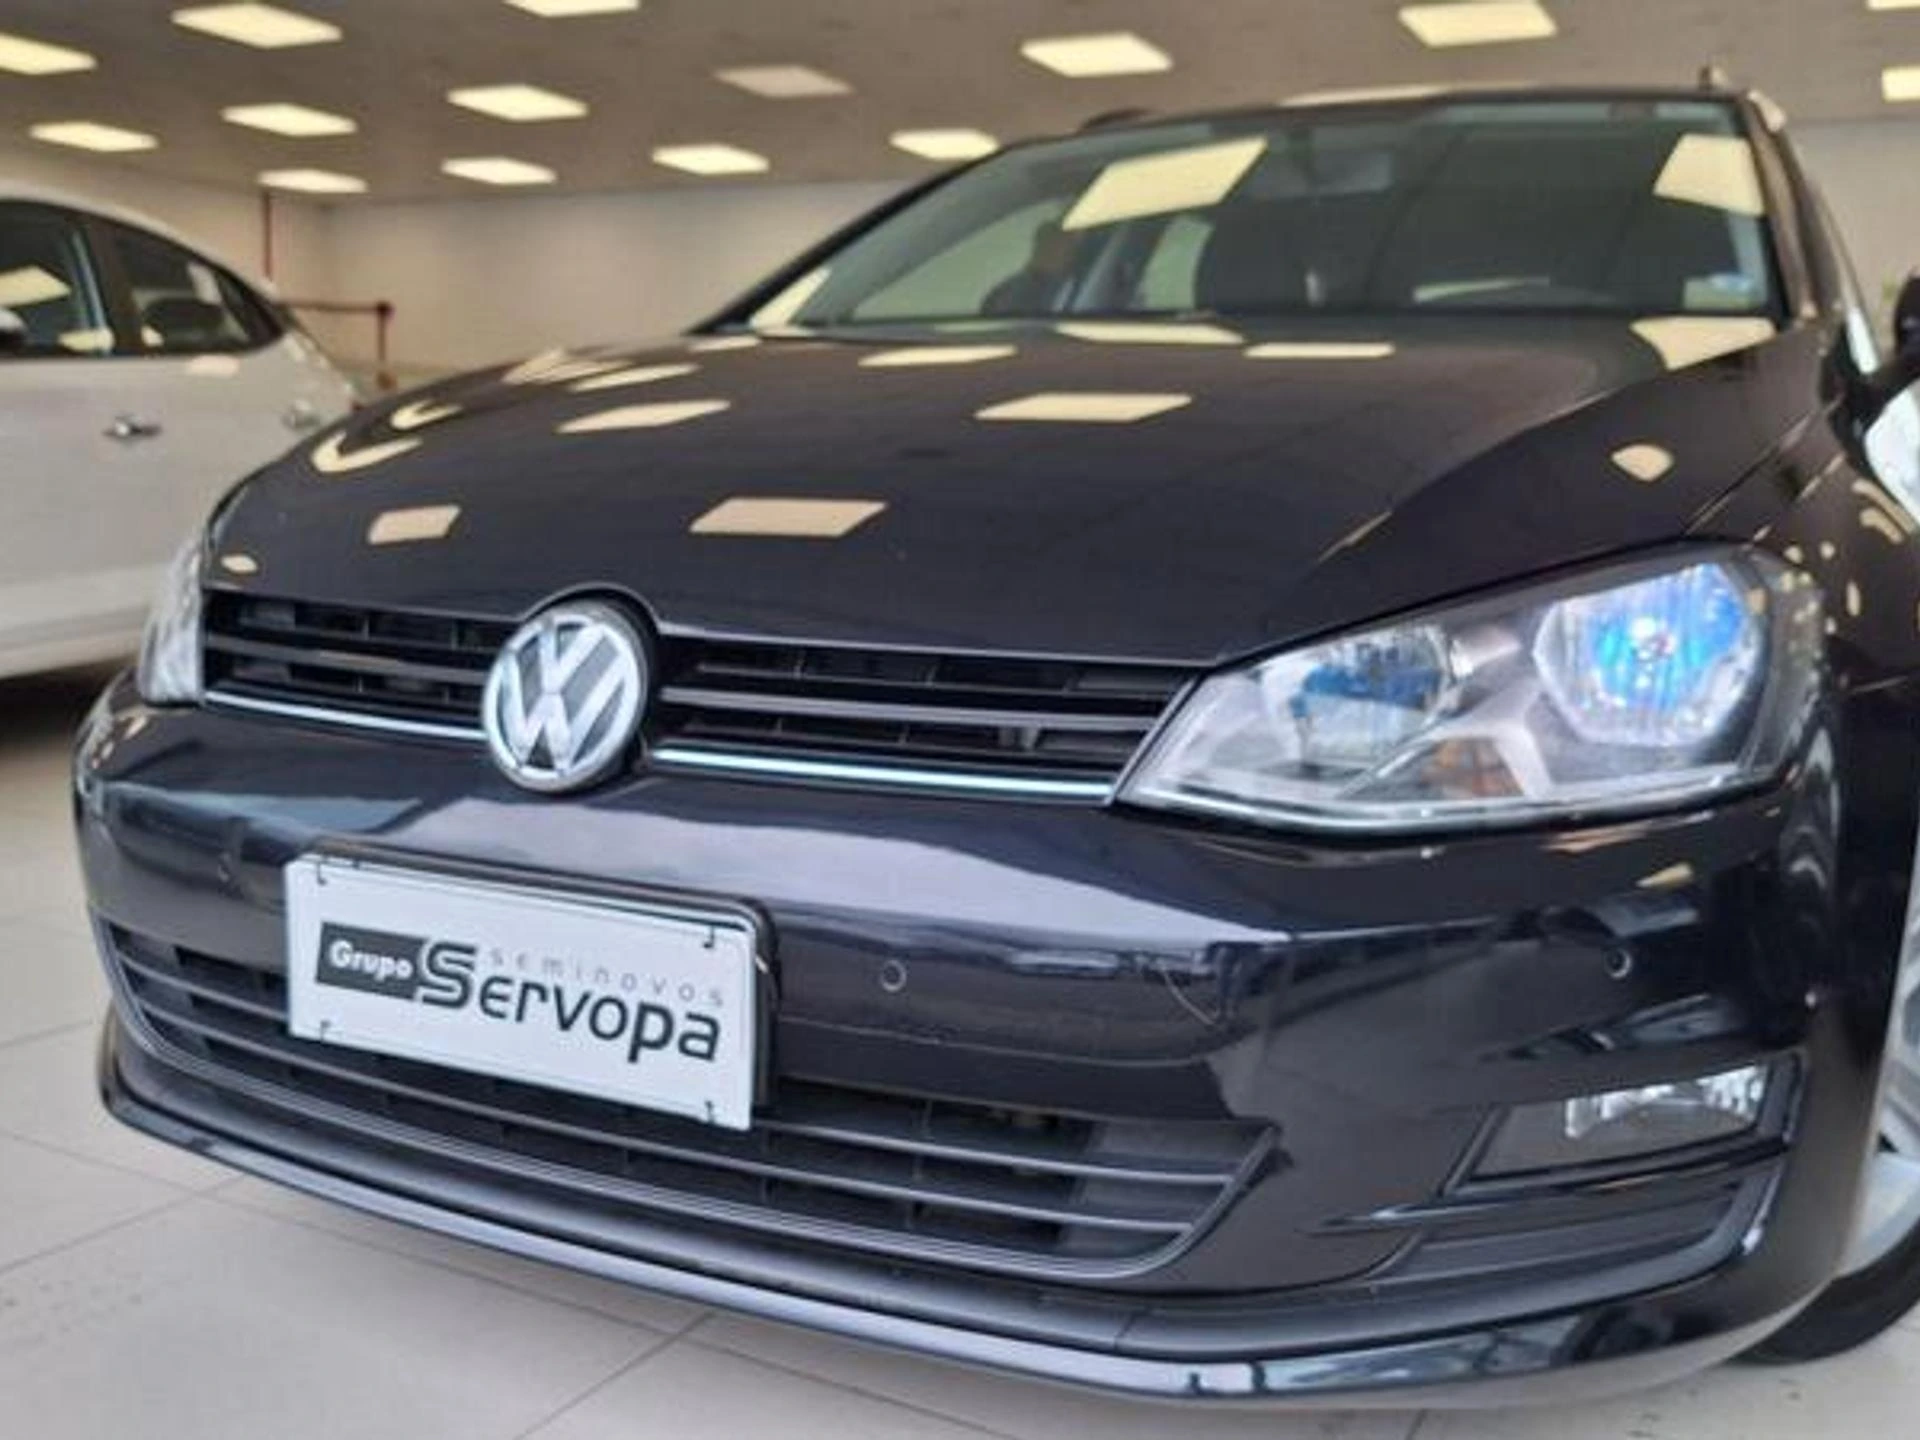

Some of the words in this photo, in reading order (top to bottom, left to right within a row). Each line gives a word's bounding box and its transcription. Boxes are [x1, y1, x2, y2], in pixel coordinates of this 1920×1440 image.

[328, 938, 413, 982] Grupo
[417, 941, 721, 1063] Servopa
[493, 949, 722, 1005] seminovos
